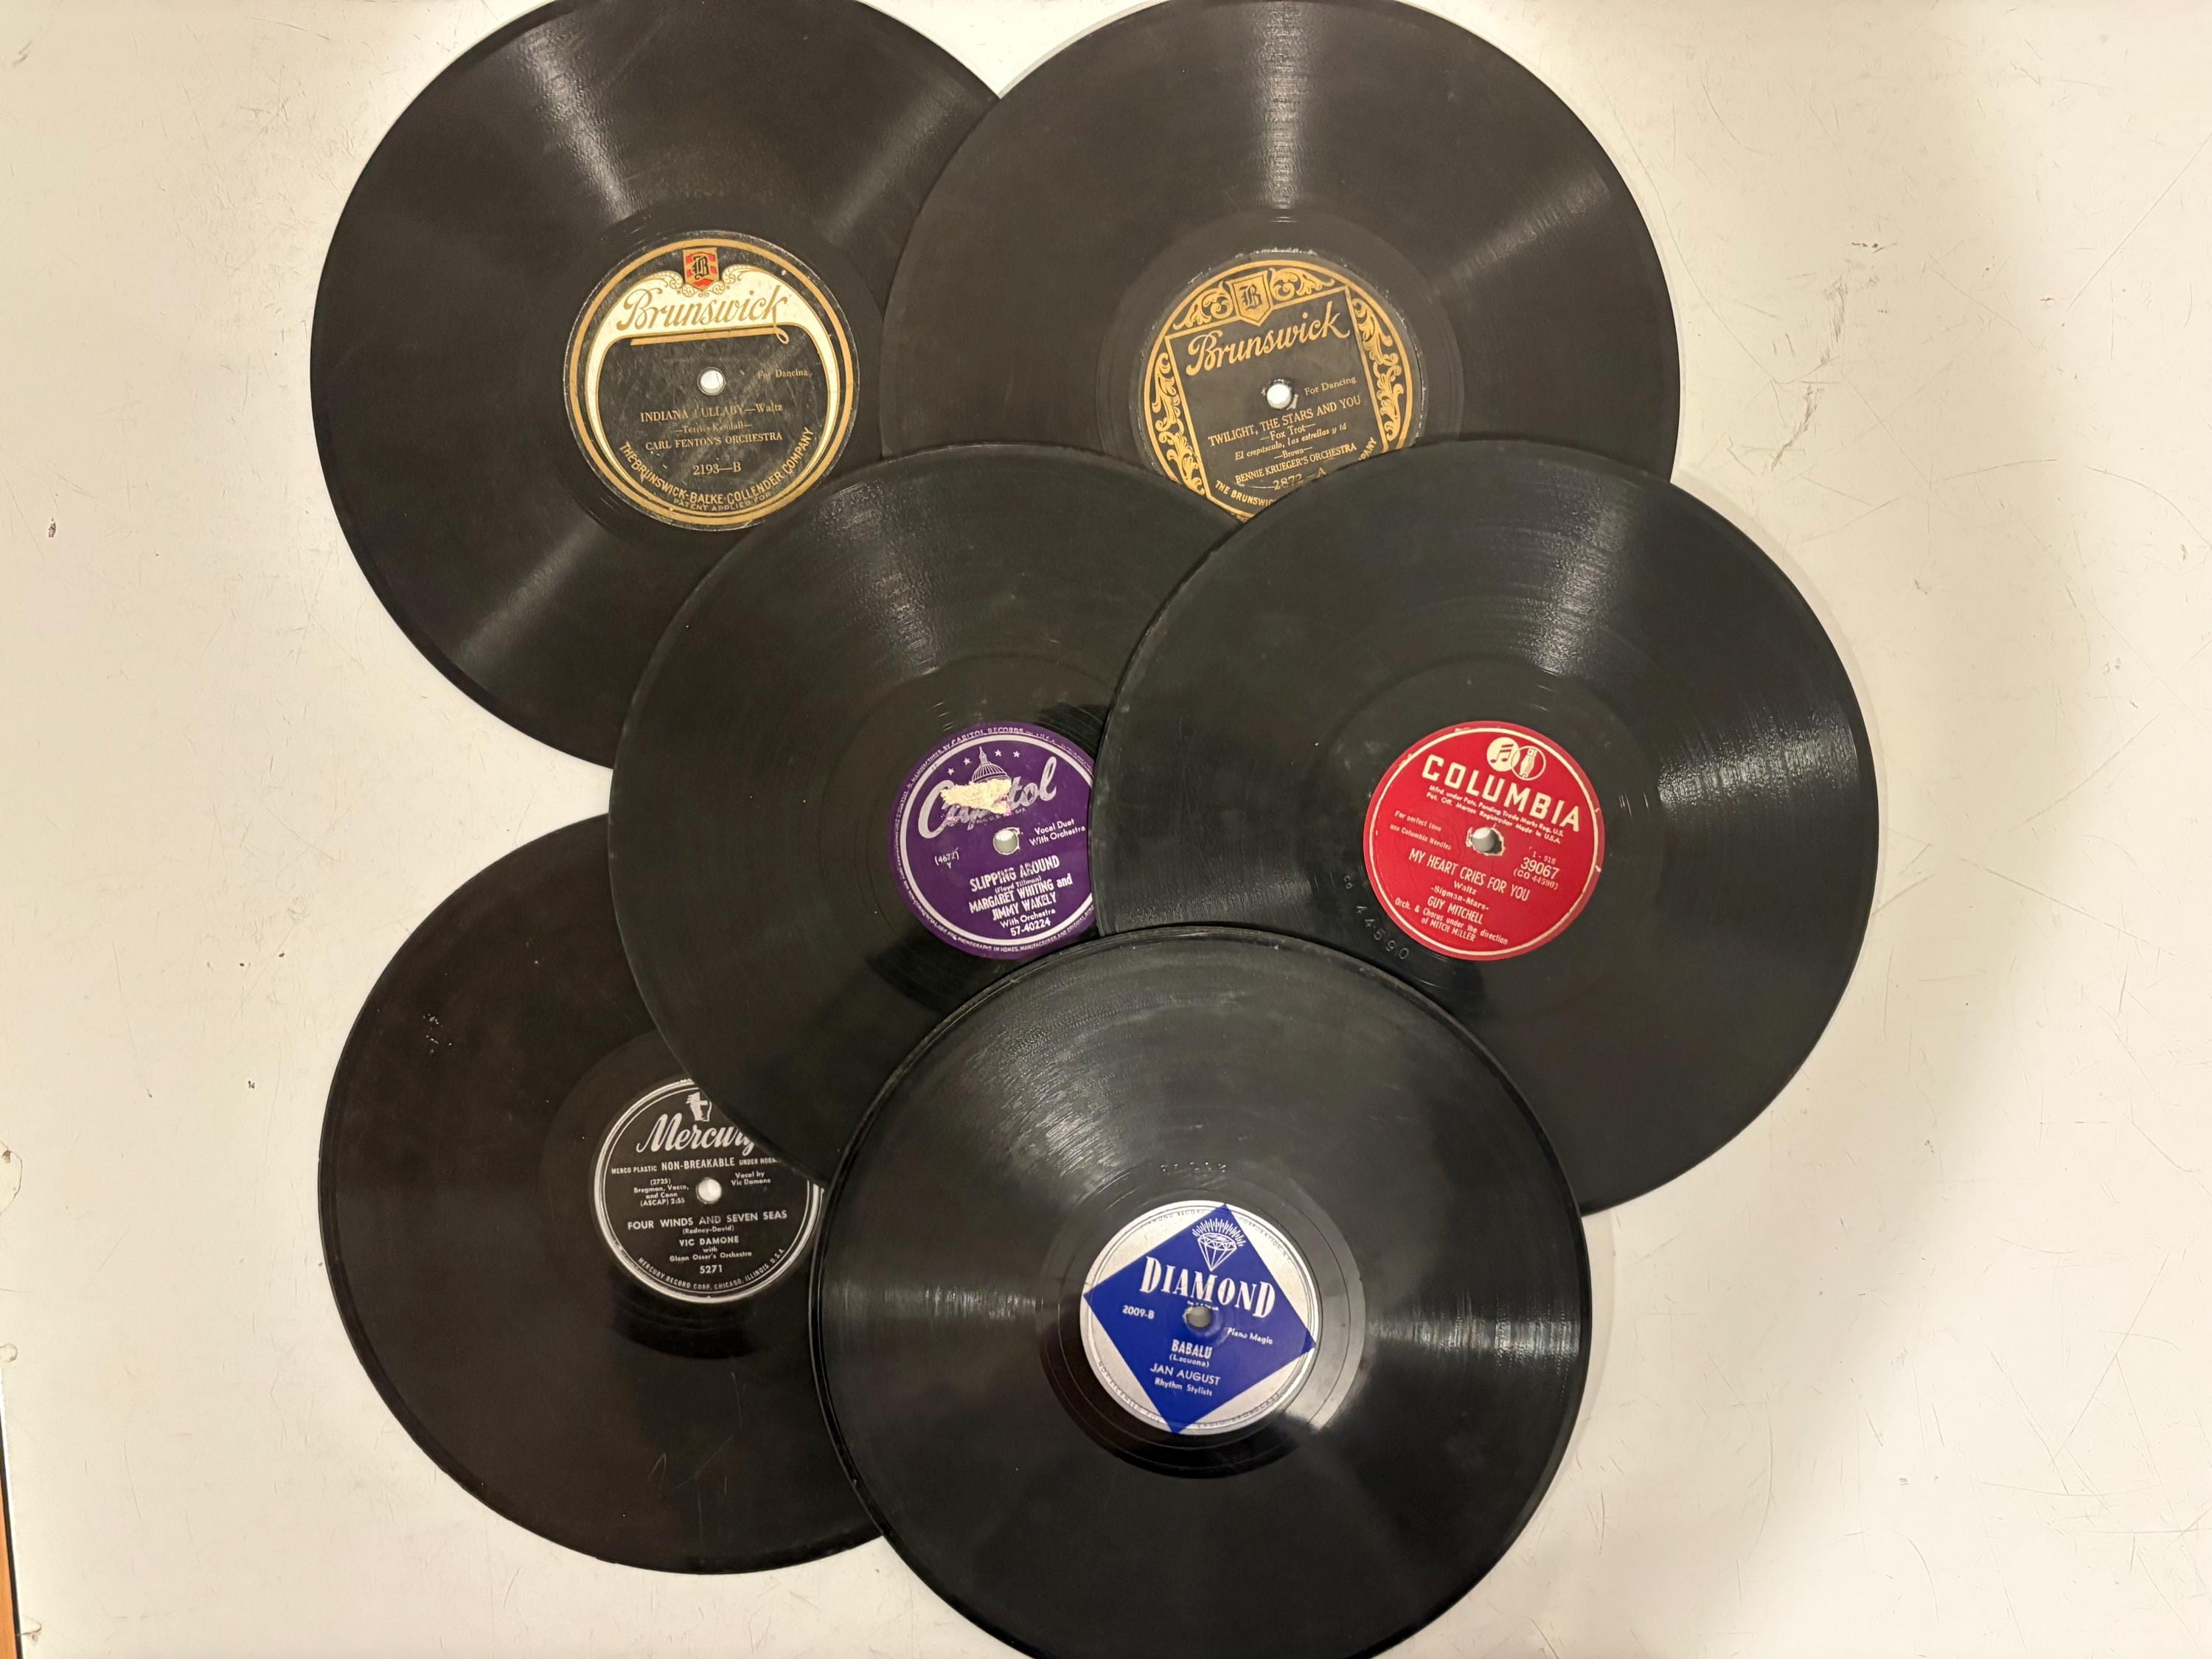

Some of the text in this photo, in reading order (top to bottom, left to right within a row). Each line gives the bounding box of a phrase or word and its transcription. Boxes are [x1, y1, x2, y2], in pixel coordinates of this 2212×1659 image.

[616, 285, 787, 332] Brunswick
[1186, 301, 1351, 376] Brunswick
[1304, 376, 1357, 395] For Dancing
[640, 409, 689, 422] INDIANA
[1208, 395, 1361, 447] TWILIGHT, THE STARS AND YOU
[646, 431, 783, 451] CARL FENTON'S ORCHESTRA
[782, 426, 814, 475] COMPANY
[1235, 451, 1245, 461] El
[1287, 437, 1299, 446] las
[1301, 428, 1329, 442] estrellas
[1332, 427, 1337, 435] y
[1234, 442, 1357, 485] BENNIE KRUEGER'S ORCHESTRA
[674, 492, 772, 511] PATENT APPLIED FOR
[1215, 480, 1276, 507] THE BRUNSWIC
[951, 730, 984, 747] CAPITOL
[918, 757, 1057, 839] Captol
[1422, 754, 1580, 832] COLUMBIA
[1394, 810, 1441, 832] For perfect tone
[1426, 792, 1438, 801] Pat.
[1441, 797, 1453, 806] Off.
[1455, 803, 1476, 814] Marcas
[1515, 824, 1532, 834] Made
[1446, 792, 1462, 801] under
[1463, 796, 1477, 807] Pats.
[1478, 801, 1501, 815] Pending
[1502, 809, 1519, 821] Trade
[1520, 818, 1537, 828] Marks
[1538, 823, 1551, 833] Reg.
[1029, 825, 1085, 846] With Orchestra
[1034, 818, 1075, 835] Vocal Duet
[1390, 824, 1451, 850] use Columbia Needles
[970, 855, 1060, 892] SLIPPING AROUND
[1408, 848, 1530, 902] MY HEART CRIES FOR YOU
[1513, 868, 1530, 880] (CO
[1520, 857, 1559, 880] 39067
[969, 873, 1073, 914] MARGARET WHITING and
[995, 875, 1042, 894] (Floyd Tillman)
[1454, 880, 1477, 895] Waltz
[992, 891, 1057, 921] JIMMY WAKELY
[1427, 896, 1484, 925] GUY MITCHELL
[1000, 917, 1019, 928] With
[1020, 908, 1056, 922] Orchestra
[1010, 918, 1051, 936] 57-40224
[1395, 897, 1509, 945] Orch. & Chorus under the direction
[1422, 917, 1476, 942] of MITCH MILLER
[636, 1113, 755, 1156] Mercury
[633, 1165, 658, 1173] PLASTIC
[661, 1158, 735, 1171] NON-BREAKABLE
[734, 1170, 765, 1179] Vocal by
[633, 1186, 665, 1194] Bregman,
[744, 1178, 771, 1186] Damone
[640, 1198, 669, 1208] (ASCAP)
[627, 1210, 787, 1231] FOUR WINDS AND SEVEN SEAS
[679, 1236, 740, 1247] VIC DAMONE
[669, 1254, 689, 1262] Glenn
[720, 1251, 752, 1259] Orchestra
[638, 1257, 665, 1279] MERCURY
[665, 1276, 691, 1289] RECORD
[745, 1263, 770, 1281] ILLINOIS
[699, 1264, 723, 1275] 5271
[1139, 1255, 1276, 1318] DIAMOND
[1122, 1304, 1155, 1320] 2009-B
[1227, 1326, 1273, 1346] Piano Magic
[1171, 1339, 1213, 1360] BABALU
[1150, 1363, 1221, 1386] JAN AUGUST
[1154, 1377, 1212, 1397] Rhythm Stylists
